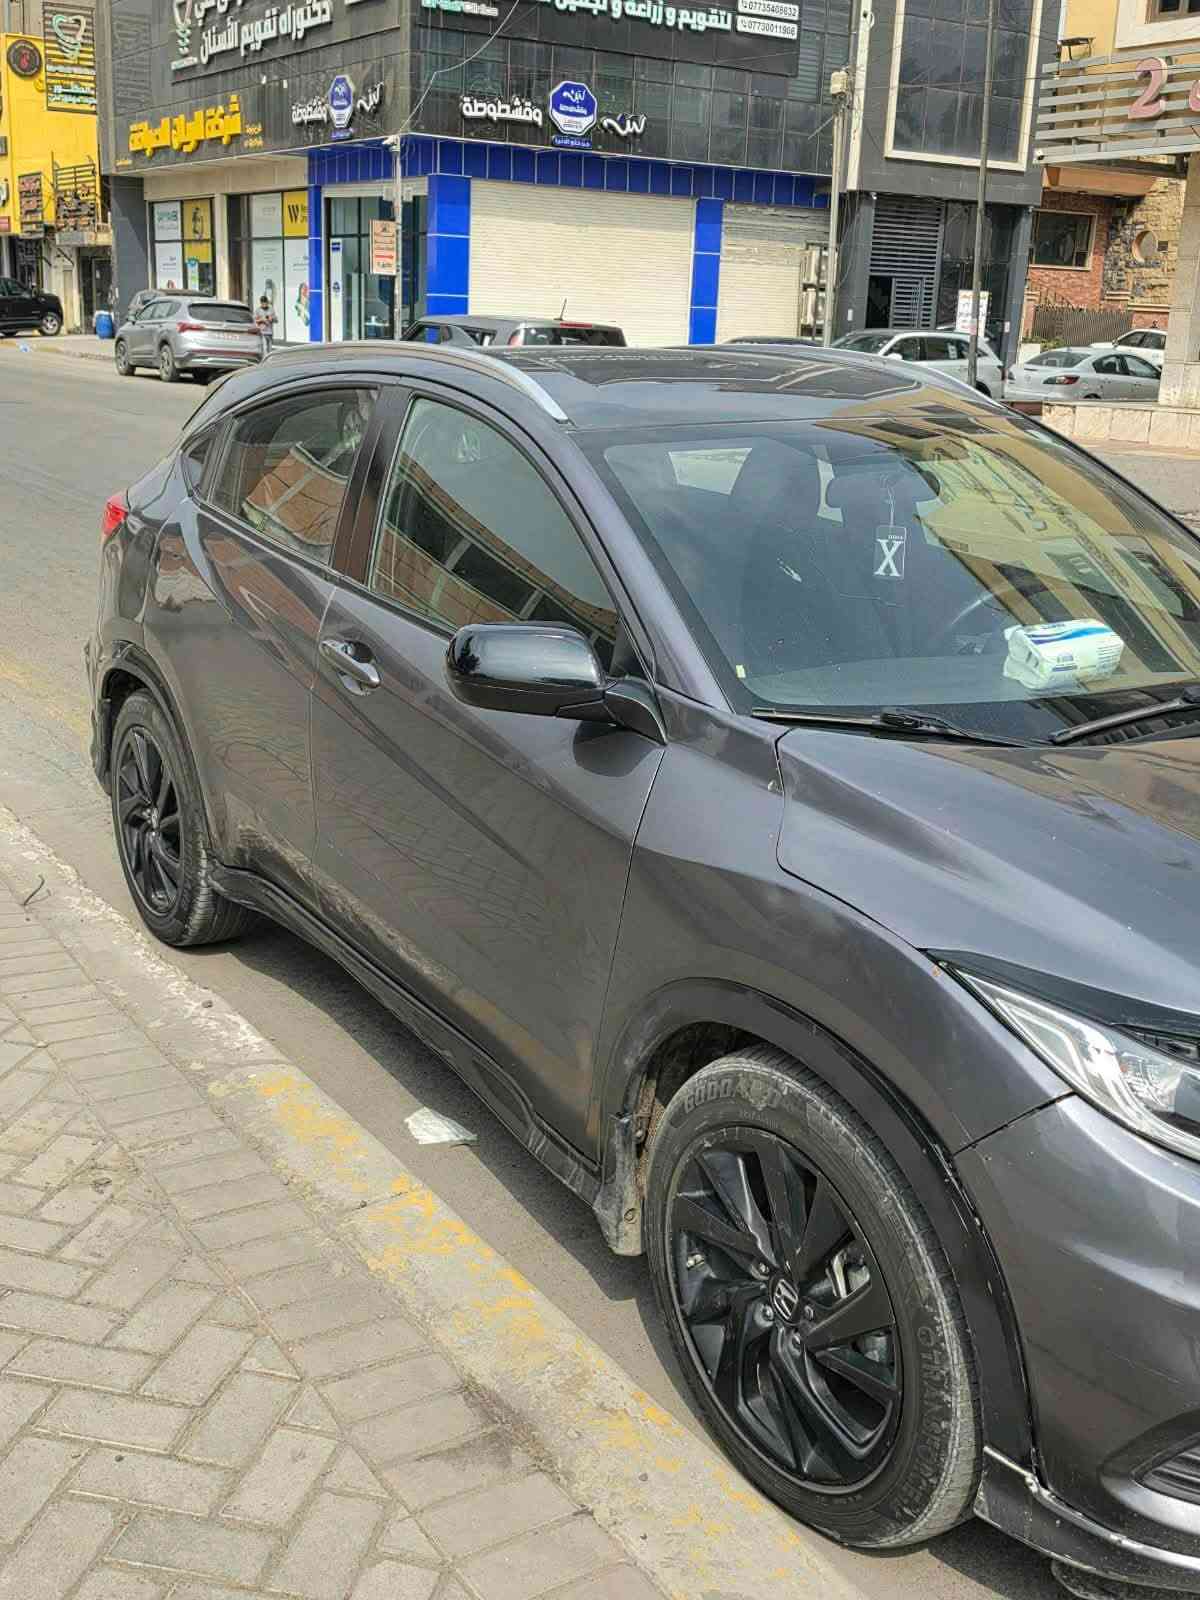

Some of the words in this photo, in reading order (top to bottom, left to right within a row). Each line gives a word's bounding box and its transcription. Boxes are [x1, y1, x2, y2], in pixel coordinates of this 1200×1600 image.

[241, 7, 279, 56] تقويم
[678, 7, 732, 31] لتقويم
[1127, 56, 1168, 119] 2
[873, 539, 905, 577] X
